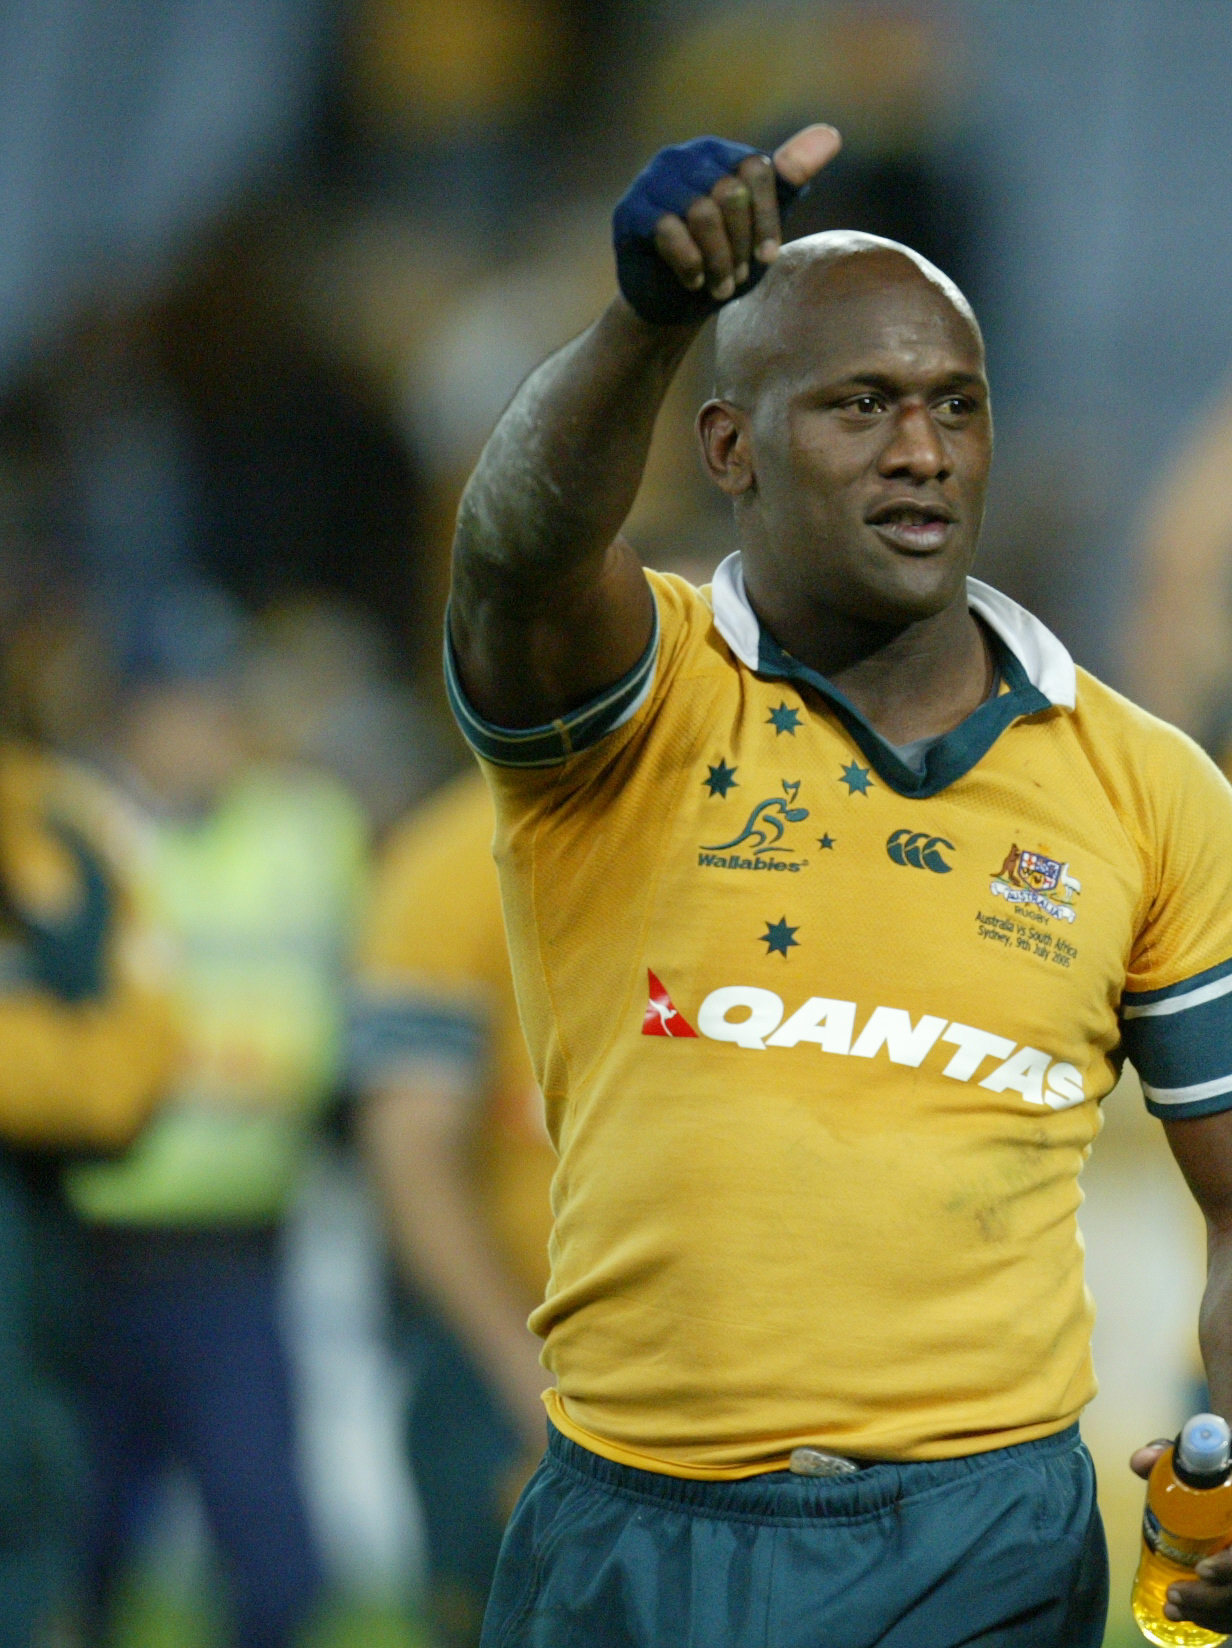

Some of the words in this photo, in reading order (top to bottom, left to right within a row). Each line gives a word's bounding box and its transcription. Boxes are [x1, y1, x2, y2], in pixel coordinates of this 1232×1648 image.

[975, 911, 1014, 932] Australia
[1016, 924, 1027, 936] vs
[1028, 928, 1053, 946] South
[1054, 938, 1077, 959] Africa
[978, 925, 1012, 947] Sydney,
[1016, 938, 1031, 951] 9th
[1033, 944, 1050, 961] July
[697, 985, 1086, 1111] QANTAS
